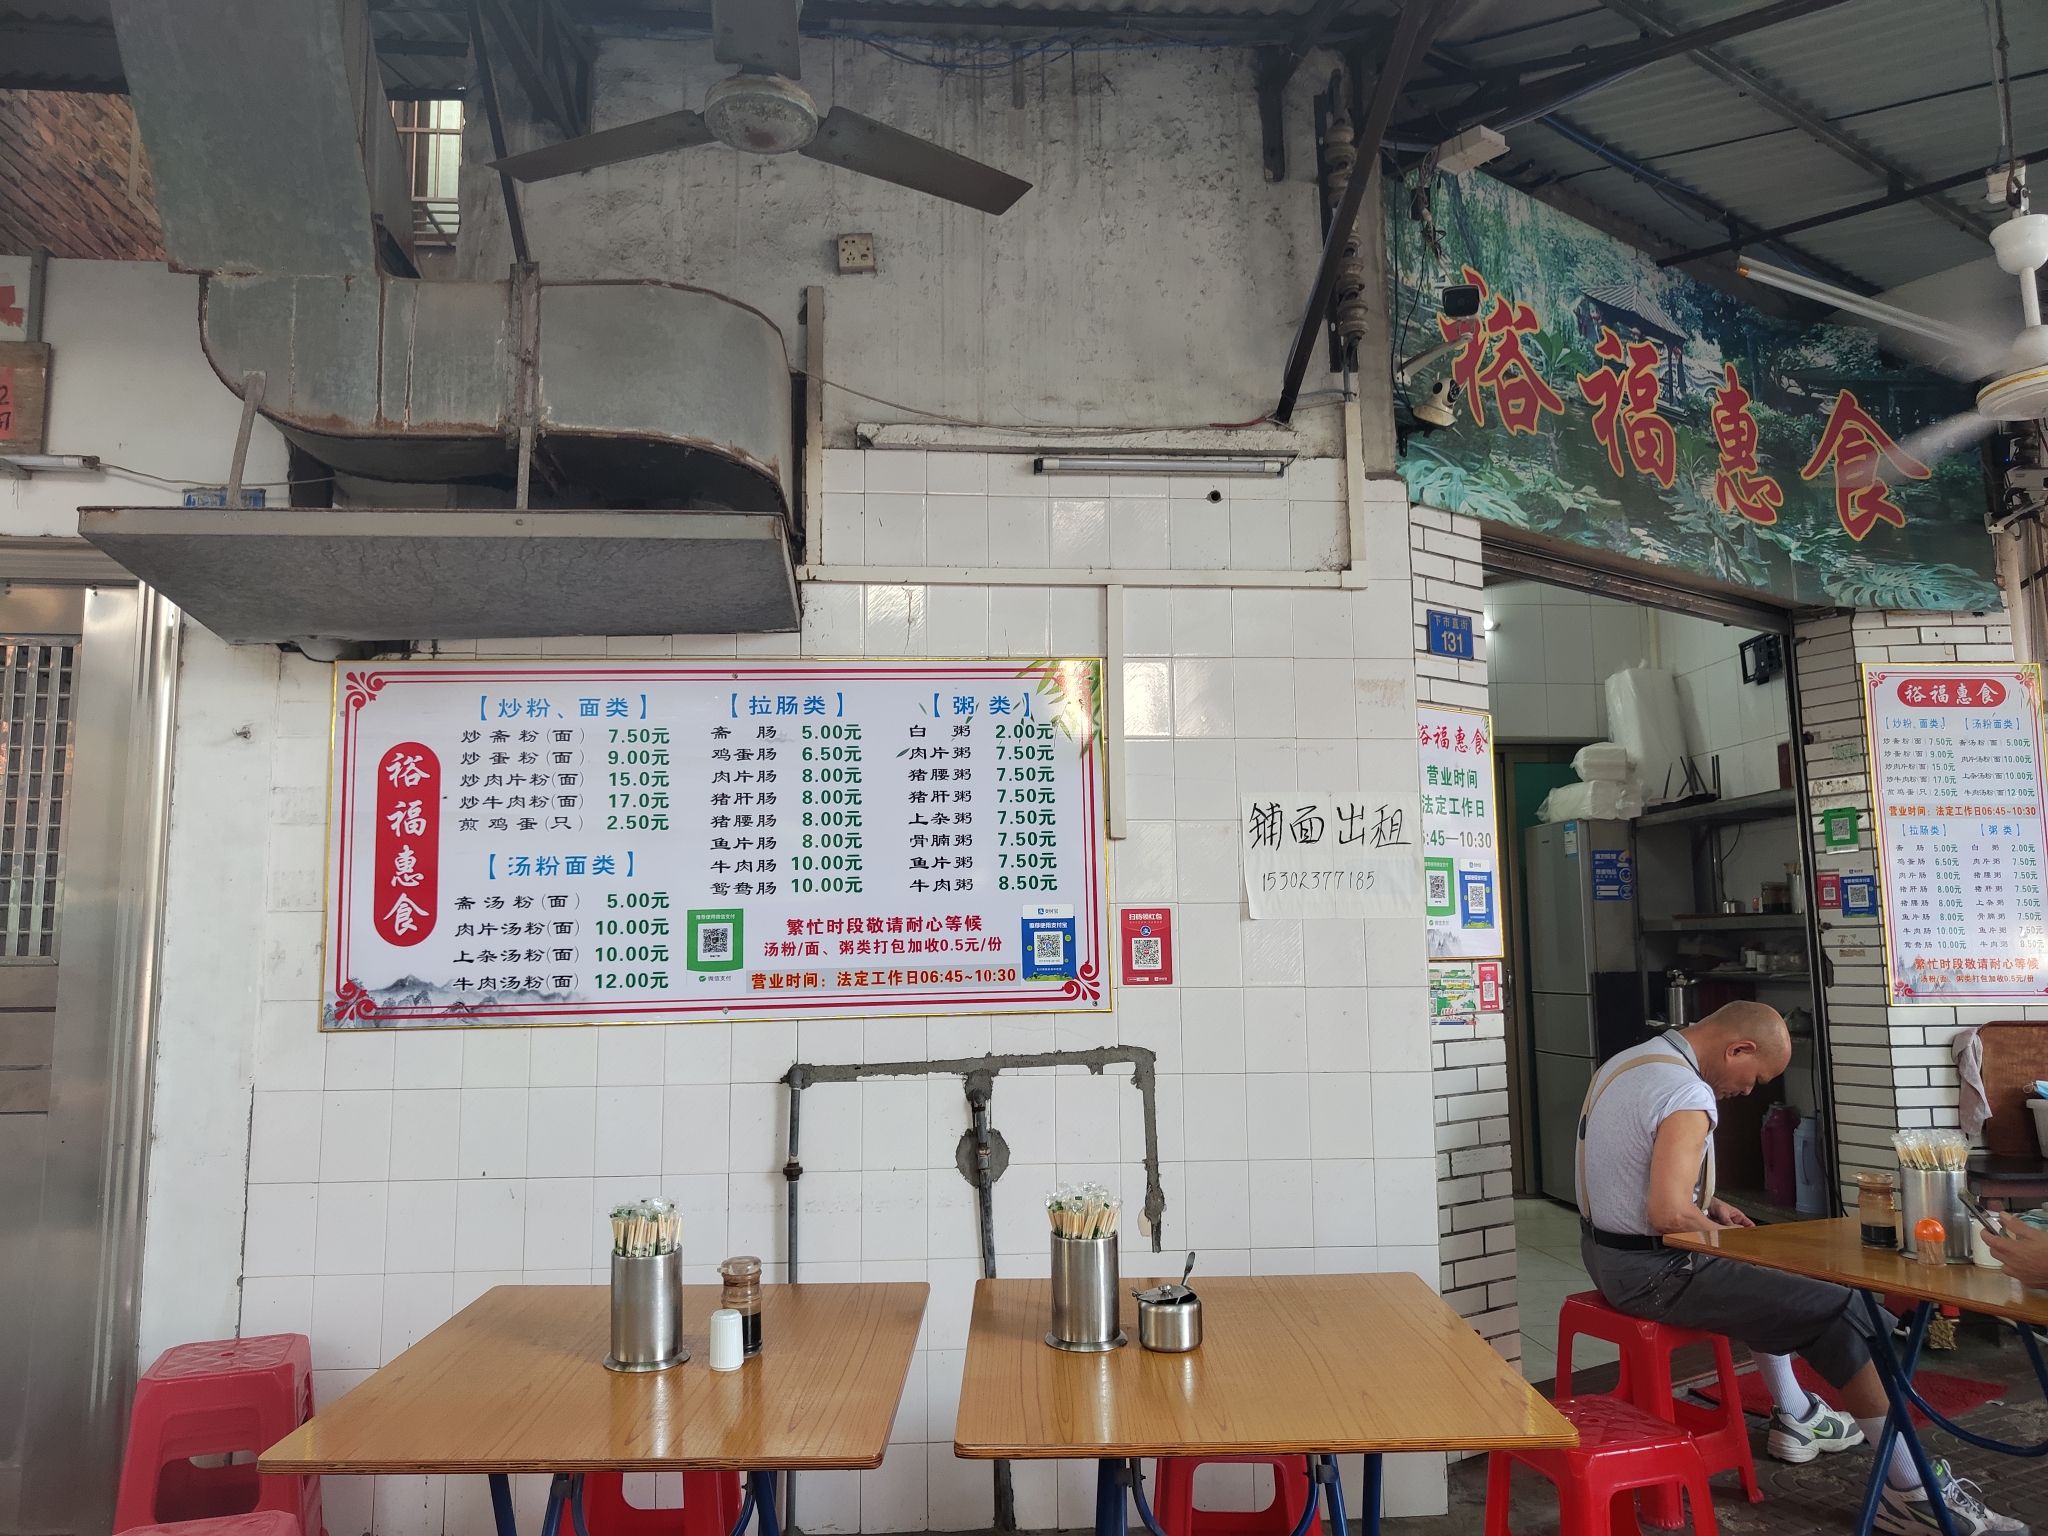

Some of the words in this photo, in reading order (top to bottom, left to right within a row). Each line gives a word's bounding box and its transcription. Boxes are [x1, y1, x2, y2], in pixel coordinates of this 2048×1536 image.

[1437, 264, 1931, 541] 裕福惠食
[1442, 631, 1462, 653] 131
[1904, 682, 1999, 705] 裕福惠食
[608, 727, 670, 744] 7.50元
[802, 724, 862, 741] 5.00元
[995, 724, 1054, 739] 2.00元
[1929, 738, 1953, 746] 7.50元
[2007, 739, 2031, 747] 5.00元
[608, 749, 670, 766] 9.00元
[711, 748, 777, 761] 鸡蛋肠
[802, 746, 862, 762] 6.50元
[909, 747, 971, 759] 肉片粥
[996, 745, 1054, 761] 7.50元
[1930, 751, 1954, 759] 9.00元
[2004, 755, 2032, 764] 10.00元
[908, 769, 972, 782] 猪腰粥
[997, 767, 1055, 783] 7.50元
[1932, 763, 1956, 771] 15.0元
[609, 771, 670, 788] 15.0元
[712, 770, 777, 784] 肉片肠
[802, 768, 862, 784] 8.00元
[1427, 765, 1478, 789] 营业时间
[1933, 776, 1957, 784] 17.0元
[2006, 772, 2033, 780] 10.00元
[609, 793, 670, 809] 17.0元
[710, 792, 777, 806] 猪肝肠
[802, 789, 862, 805] 8.00元
[908, 790, 972, 804] 猪肝粥
[997, 788, 1056, 804] 7.50元
[1934, 789, 1958, 797] 2.50元
[2007, 789, 2035, 797] 12.00元
[1422, 795, 1485, 818] 法定工作日
[607, 815, 669, 831] 2.50元
[710, 814, 777, 828] 猪腰肠
[802, 811, 862, 827] 8.00元
[909, 812, 972, 825] 上杂粥
[997, 810, 1056, 826] 7.50元
[384, 751, 430, 936] 裕福惠食
[710, 836, 777, 850] 鱼片肠
[802, 833, 862, 849] 8.00元
[910, 834, 973, 848] 骨腩粥
[998, 831, 1056, 847] 7.50元
[1934, 844, 1958, 852] 5.00元
[710, 859, 777, 873] 牛肉肠
[791, 855, 863, 871] 10.00元
[909, 856, 973, 870] 鱼片粥
[999, 853, 1057, 869] 7.50元
[1935, 858, 1959, 866] 6.50元
[910, 879, 973, 893] 牛肉粥
[999, 875, 1057, 891] 8.50元
[1262, 871, 1376, 892] 15302377185
[1936, 872, 1960, 880] 8.00元
[710, 881, 777, 896] 鸳鸯肠
[791, 877, 863, 893] 10.00元
[1937, 886, 1962, 894] 8.00元
[607, 892, 670, 909] 5.00元
[1939, 899, 1963, 907] 8.00元
[786, 914, 983, 936] 繁忙时段敬请耐心等候
[1940, 913, 1964, 921] 8.00元
[595, 919, 670, 936] 10.00元
[1937, 927, 1966, 935] 10.00元
[1938, 941, 1967, 949] 10.00元
[595, 945, 669, 963] 10.00元
[1914, 958, 2040, 970] 繁忙时段敬请耐心等候
[594, 972, 668, 990] 12.00元
